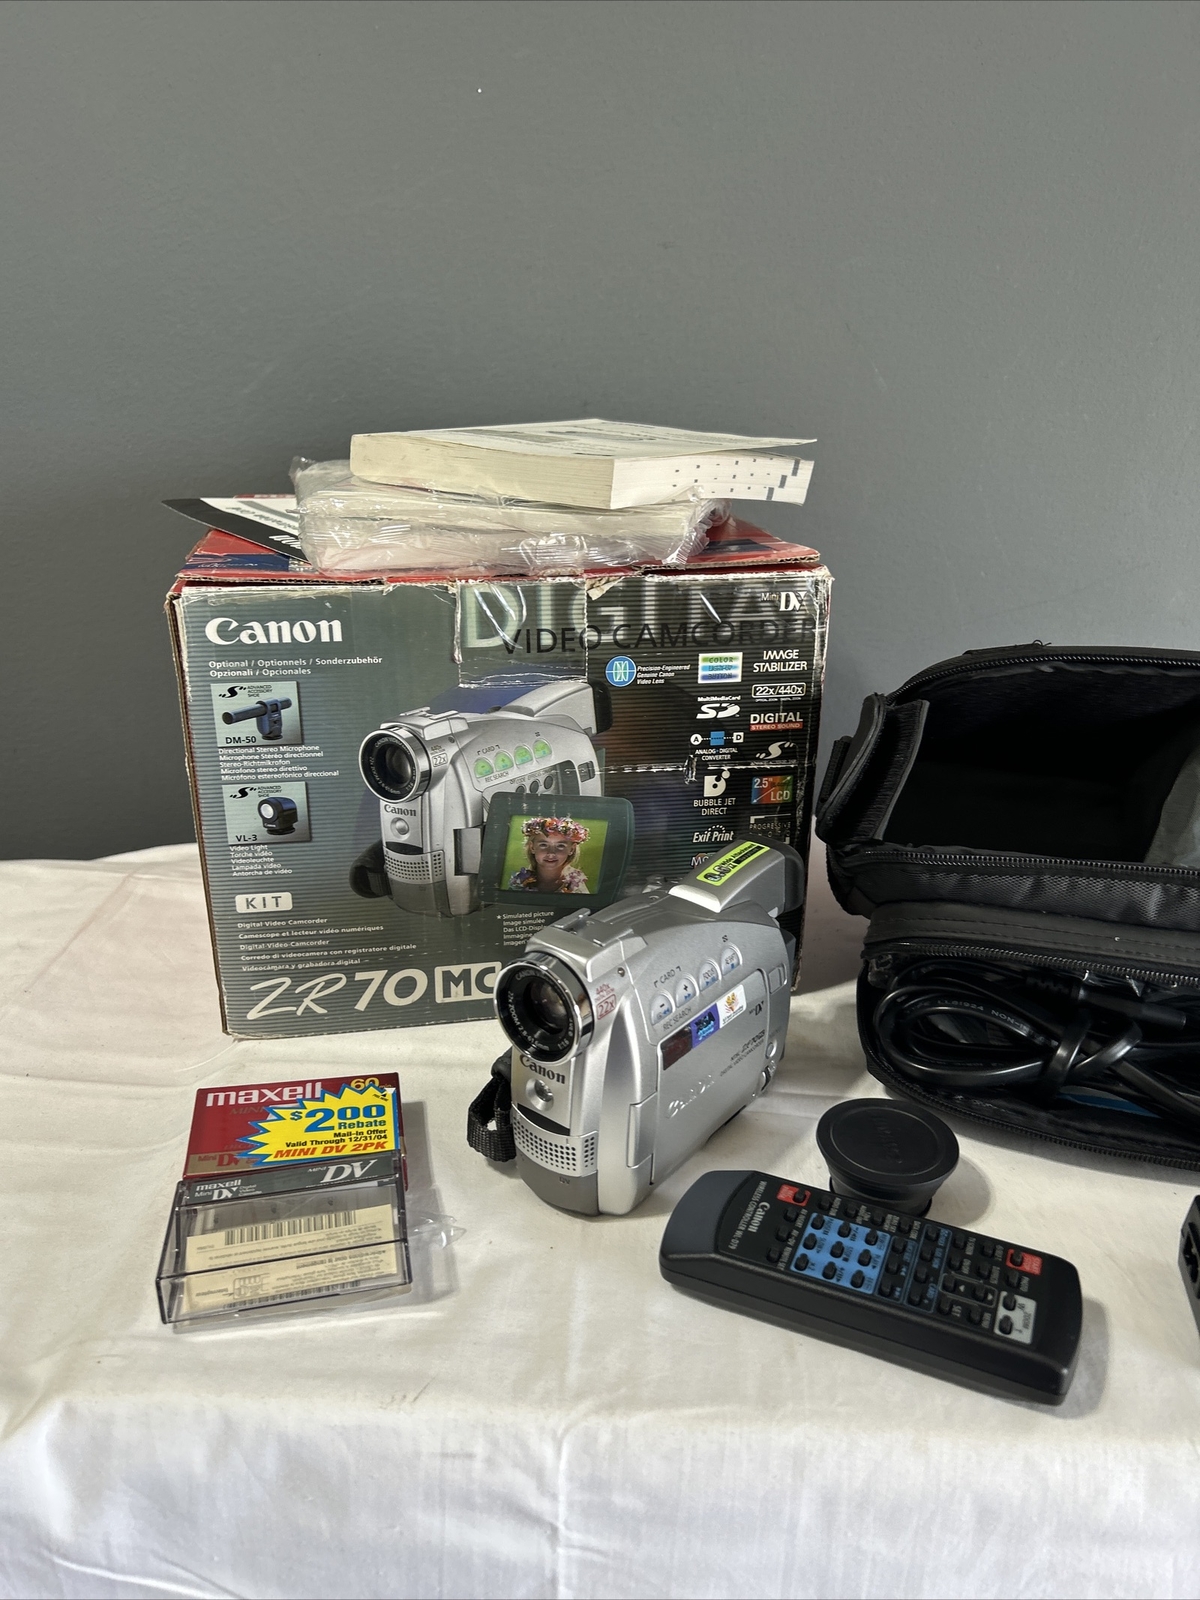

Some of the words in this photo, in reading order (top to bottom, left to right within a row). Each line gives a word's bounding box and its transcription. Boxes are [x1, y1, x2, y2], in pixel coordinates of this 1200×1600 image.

[761, 592, 778, 601] Mini
[779, 592, 806, 611] DV
[205, 617, 343, 645] Canon
[503, 625, 602, 655] VIDEO
[612, 619, 815, 650] CAMCORDER
[764, 649, 799, 660] IMAGE
[209, 660, 248, 668] Optional
[257, 658, 307, 668] Optionnels
[315, 656, 383, 665] Sonderzubehör
[753, 661, 807, 672] STABILIZER
[209, 669, 253, 678] Opzionali
[262, 667, 311, 677] Opcionales
[755, 685, 803, 696] 22x/440x
[750, 711, 803, 724] DIGITAL
[777, 722, 800, 730] SOUND
[225, 736, 257, 745] DM-50
[218, 747, 256, 755] Directional
[279, 745, 320, 753] Microphone
[283, 751, 324, 759] directionnel
[219, 759, 291, 768] Stereo-Richtmikrofon
[433, 755, 446, 766] 22x
[220, 767, 256, 775] Microfono
[278, 765, 308, 773] direttivo
[257, 772, 303, 780] estereofónico
[303, 770, 340, 778] direccional
[754, 777, 773, 789] 2.5"
[770, 790, 791, 801] LCD
[693, 798, 722, 808] BUBBLE
[723, 797, 737, 806] JET
[384, 804, 417, 817] Canon
[701, 808, 727, 816] DIRECT
[235, 834, 258, 842] VL-3
[693, 831, 711, 843] Exif
[711, 831, 734, 843] Print
[250, 844, 269, 852] Light
[231, 863, 262, 871] Lampada
[245, 895, 282, 910] KIT
[502, 912, 533, 920] Simulated
[237, 921, 263, 930] Digital
[264, 919, 286, 927] Video
[288, 917, 328, 926] Camcorder
[238, 931, 280, 940] Camescope
[291, 929, 317, 937] lecteur
[341, 925, 384, 934] numériques
[239, 943, 265, 951] Digital
[267, 941, 289, 949] Video
[290, 939, 330, 948] Camcorder
[281, 950, 328, 959] videocamera
[344, 945, 388, 955] registratore
[388, 943, 417, 952] digitale
[242, 963, 289, 972] Videocámara
[297, 959, 335, 969] grabadora
[336, 957, 361, 967] digital
[659, 968, 676, 985] CARD
[598, 1001, 616, 1016] 22x
[520, 1055, 566, 1084] Canon
[350, 1077, 380, 1091] 60
[206, 1081, 322, 1107] maxell
[338, 1119, 387, 1130] Rebate
[309, 1137, 346, 1147] Through
[348, 1134, 388, 1143] 12/31/04
[333, 1131, 365, 1139] Mail-In
[273, 1147, 318, 1159] MINI
[321, 1144, 348, 1155] DV
[350, 1141, 389, 1152] 2PK
[197, 1154, 217, 1162] Mini
[320, 1159, 379, 1184] DV
[195, 1178, 242, 1192] maxell
[194, 1189, 213, 1198] Mini
[212, 1187, 239, 1201] DV
[752, 1181, 768, 1202] WIRELESS
[737, 1200, 754, 1235] CONTROLLER
[747, 1201, 771, 1233] Canon
